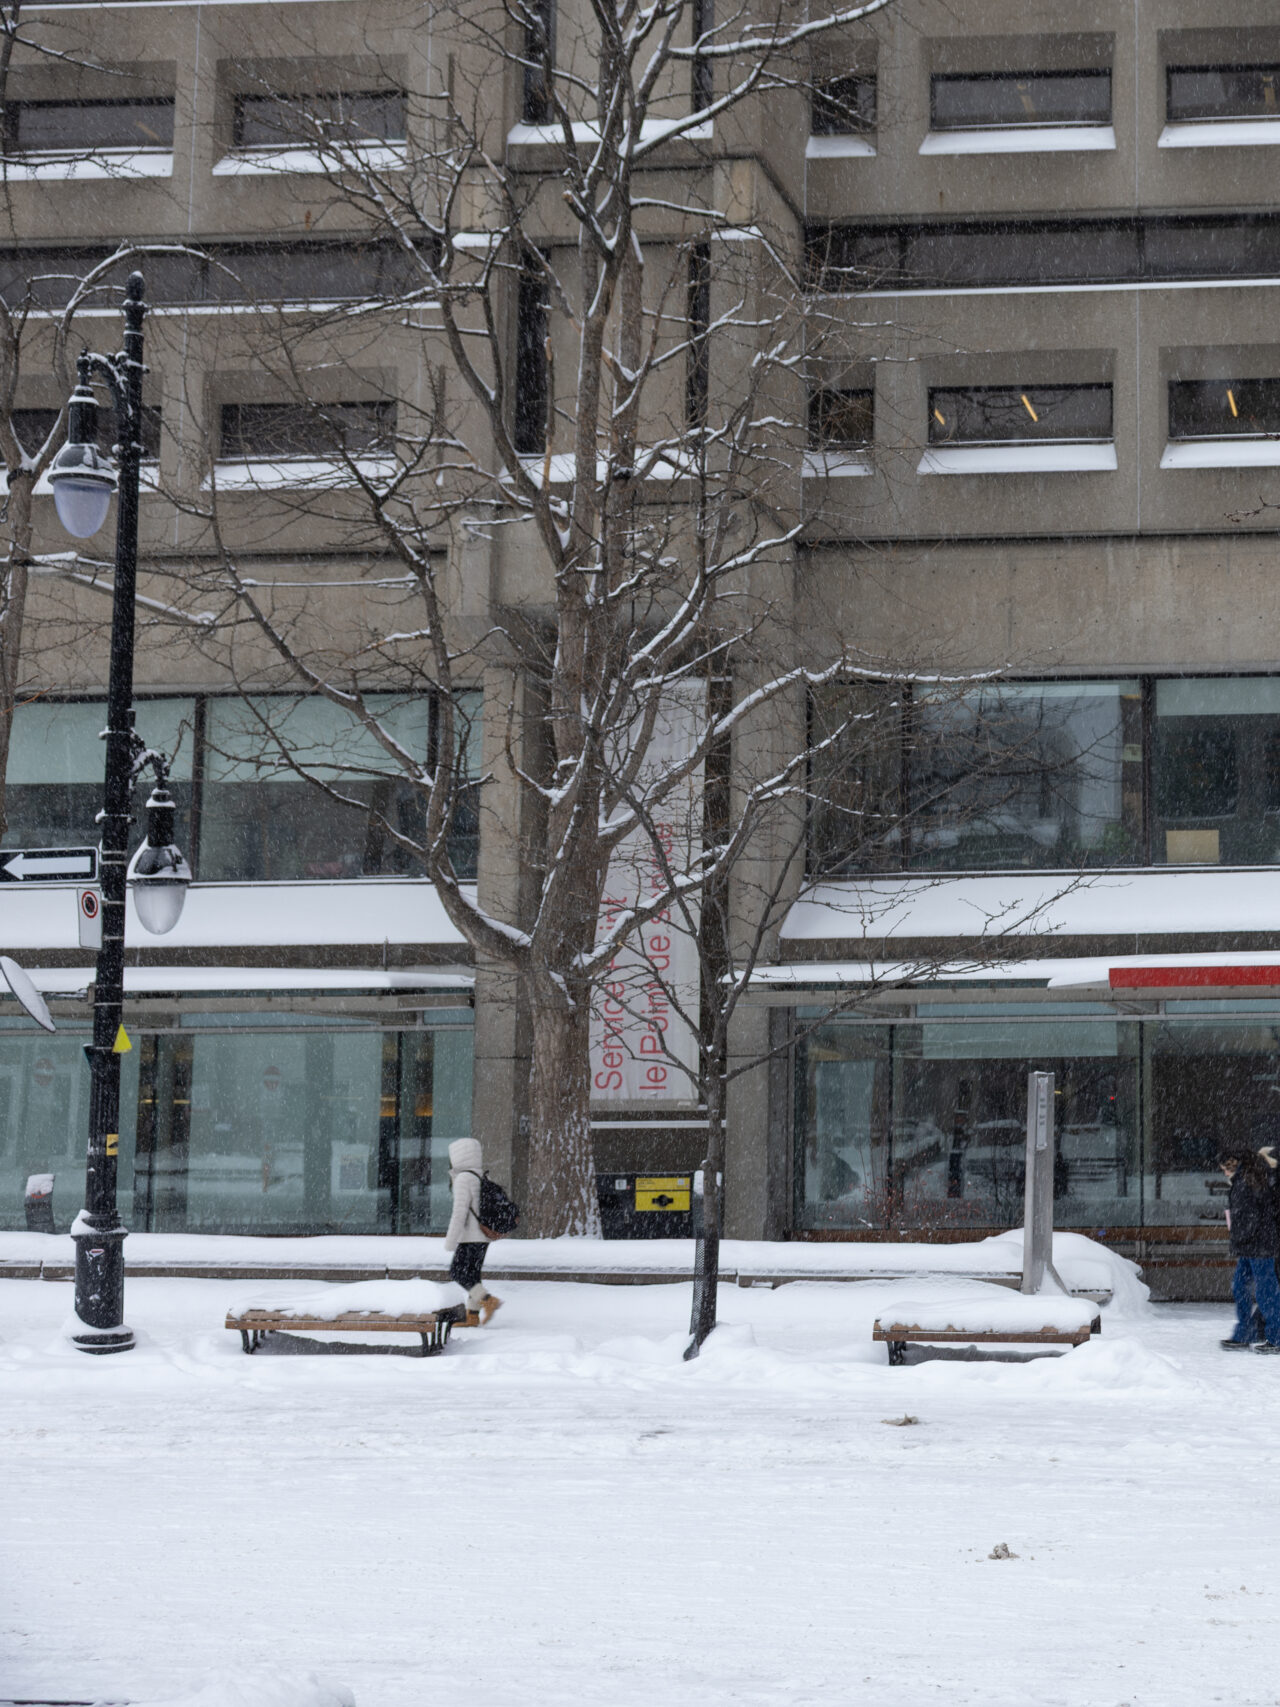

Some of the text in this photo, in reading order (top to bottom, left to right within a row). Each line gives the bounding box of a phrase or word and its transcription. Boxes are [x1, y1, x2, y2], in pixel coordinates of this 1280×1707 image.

[594, 897, 628, 1091] Service Pint
[640, 822, 673, 1091] le Point de srvice
